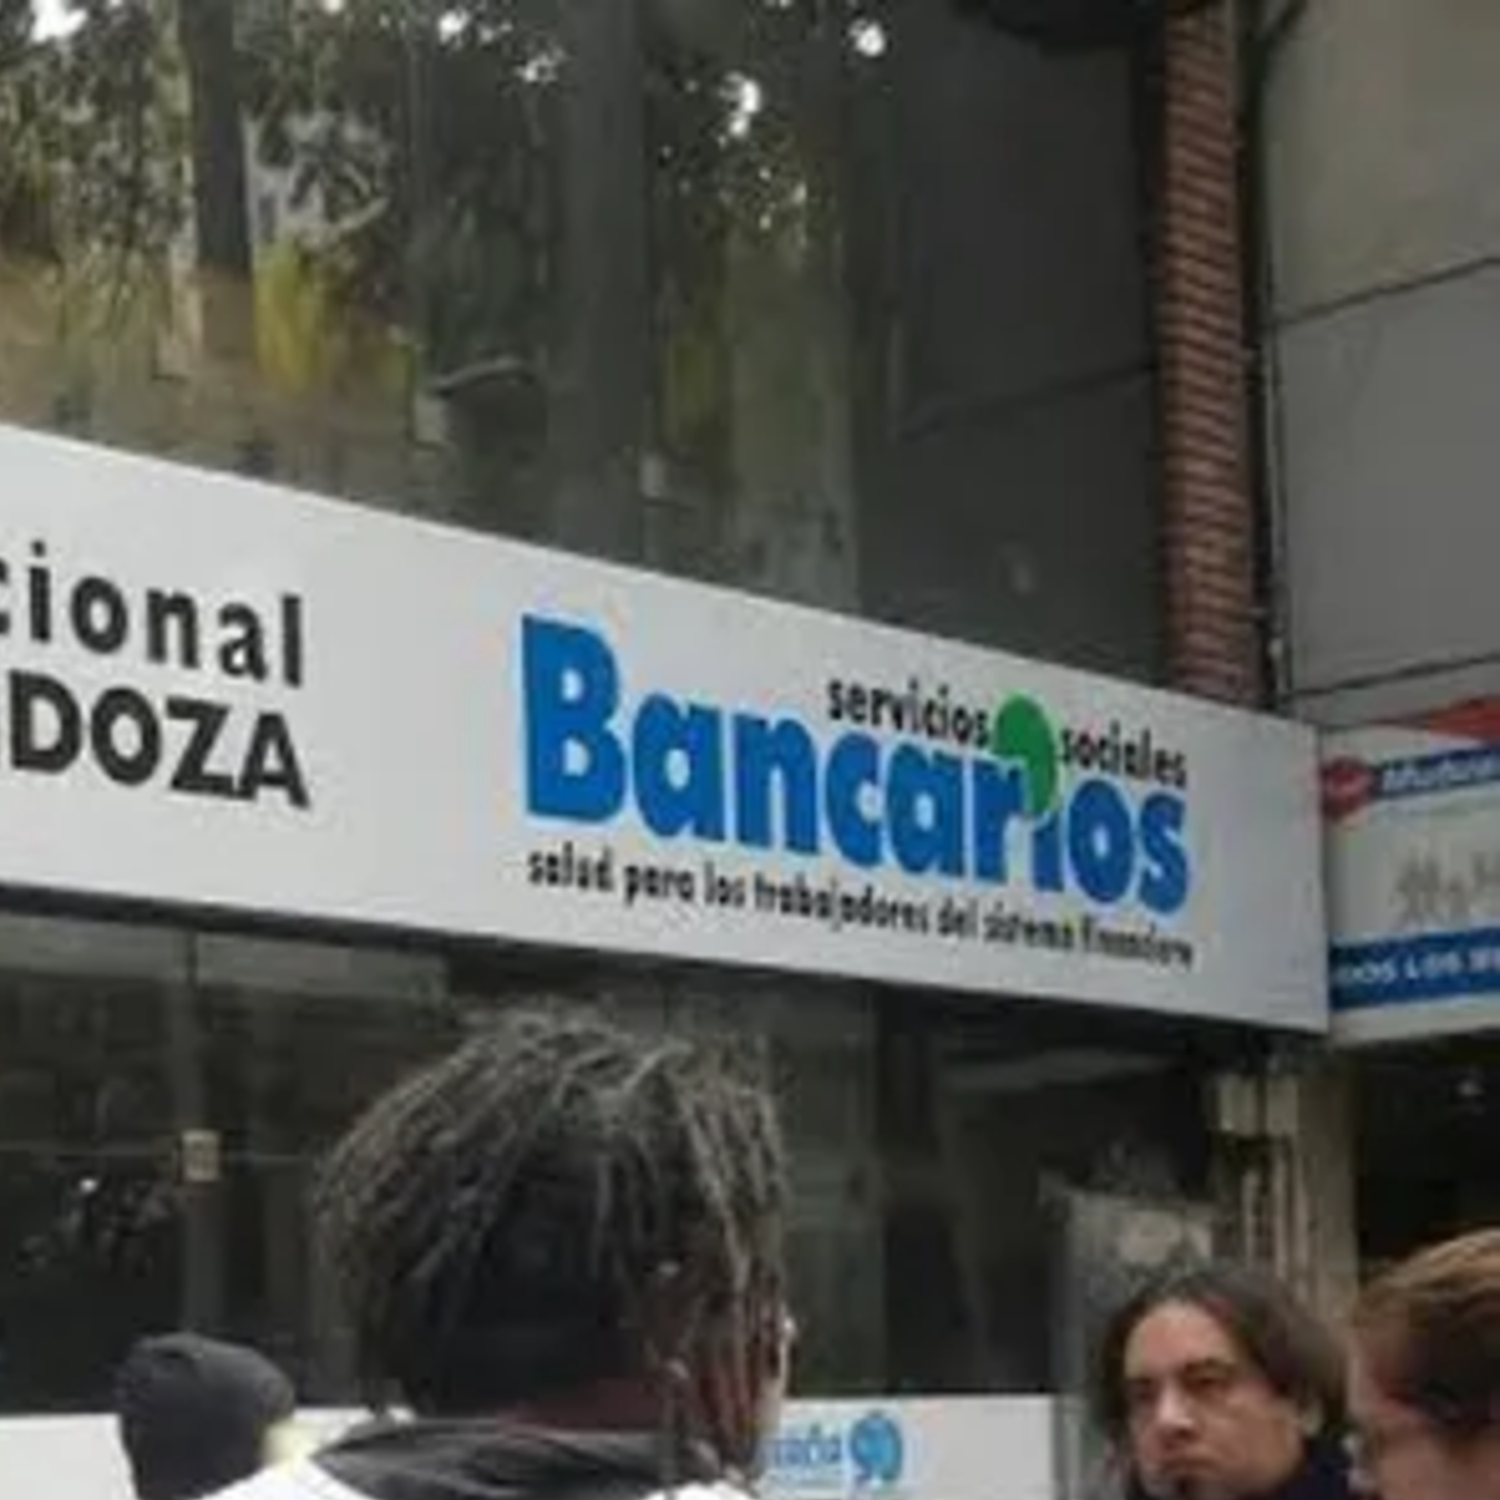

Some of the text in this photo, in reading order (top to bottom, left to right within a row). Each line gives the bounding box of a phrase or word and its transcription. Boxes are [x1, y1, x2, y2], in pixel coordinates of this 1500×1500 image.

[521, 614, 1189, 912] Bancarios
[827, 679, 1188, 788] servicios sociales
[528, 840, 613, 890] salud
[624, 864, 696, 907] para
[704, 860, 746, 907] los
[753, 870, 928, 934] trabajadores
[936, 895, 979, 938] del
